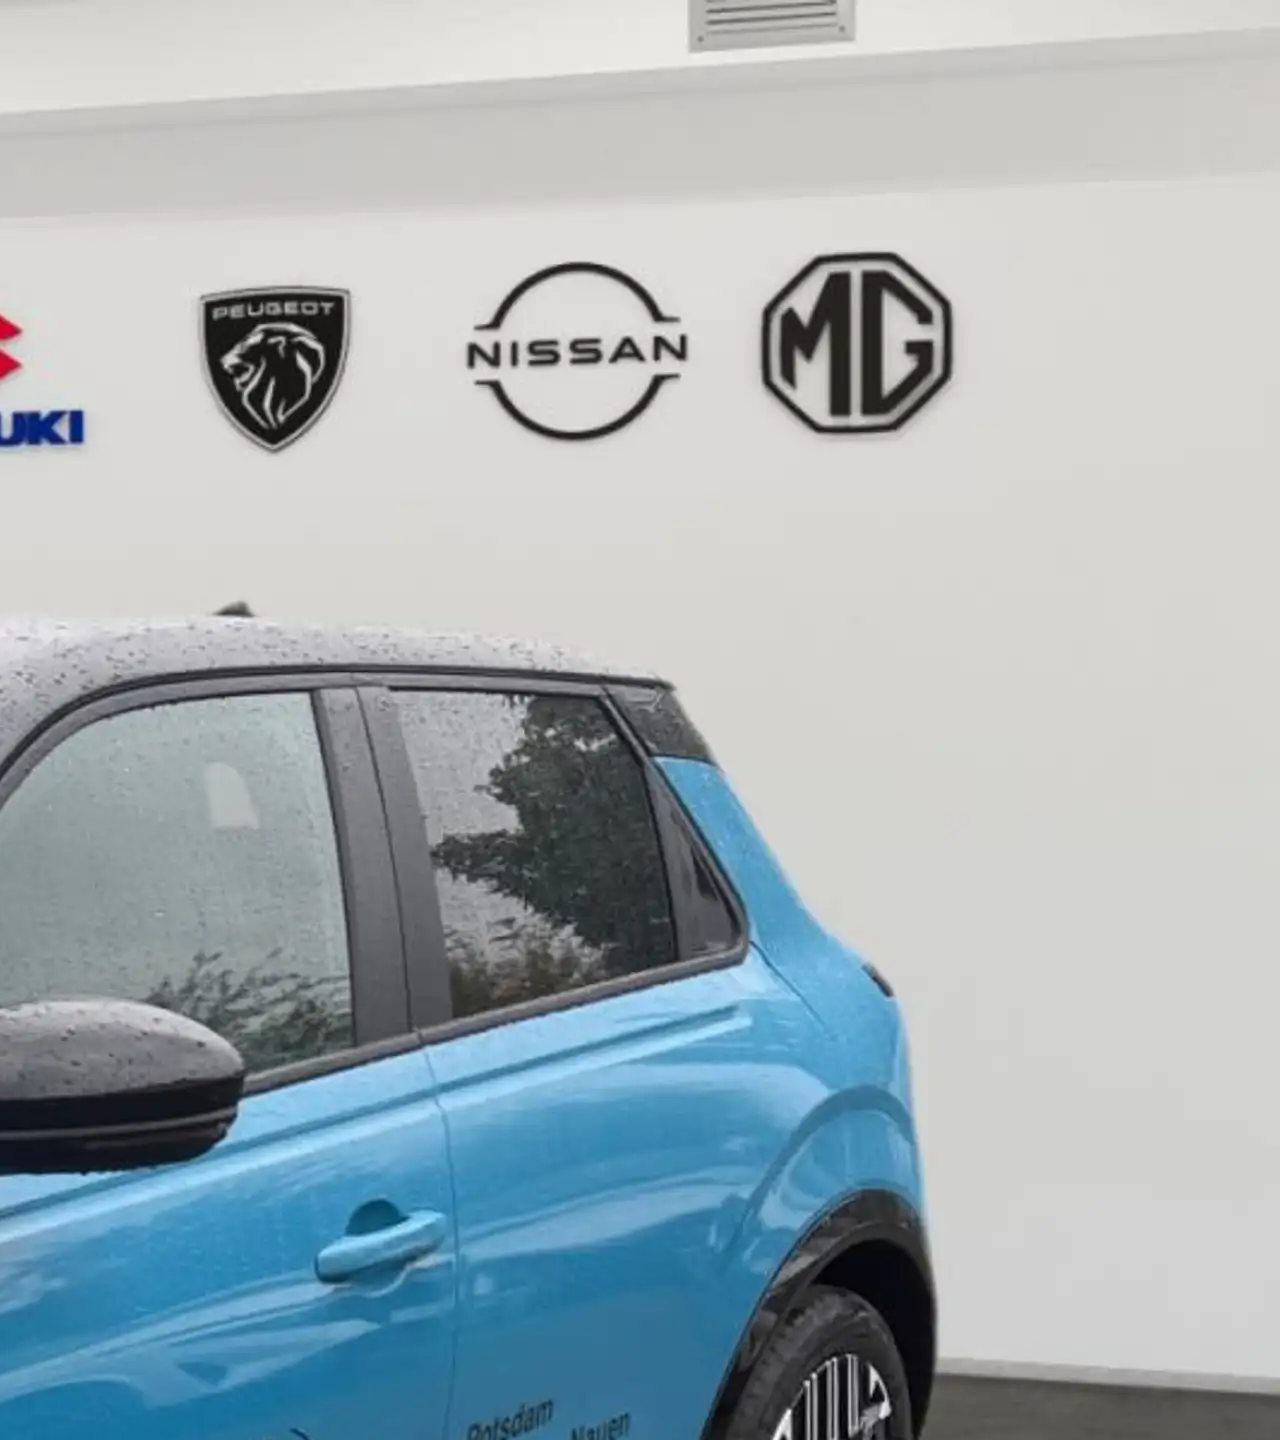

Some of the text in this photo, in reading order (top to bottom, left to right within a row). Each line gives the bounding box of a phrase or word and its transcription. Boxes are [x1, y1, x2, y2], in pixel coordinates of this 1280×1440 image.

[211, 301, 337, 321] PEUGEOT
[467, 334, 687, 369] NISSAN
[781, 270, 933, 416] MG
